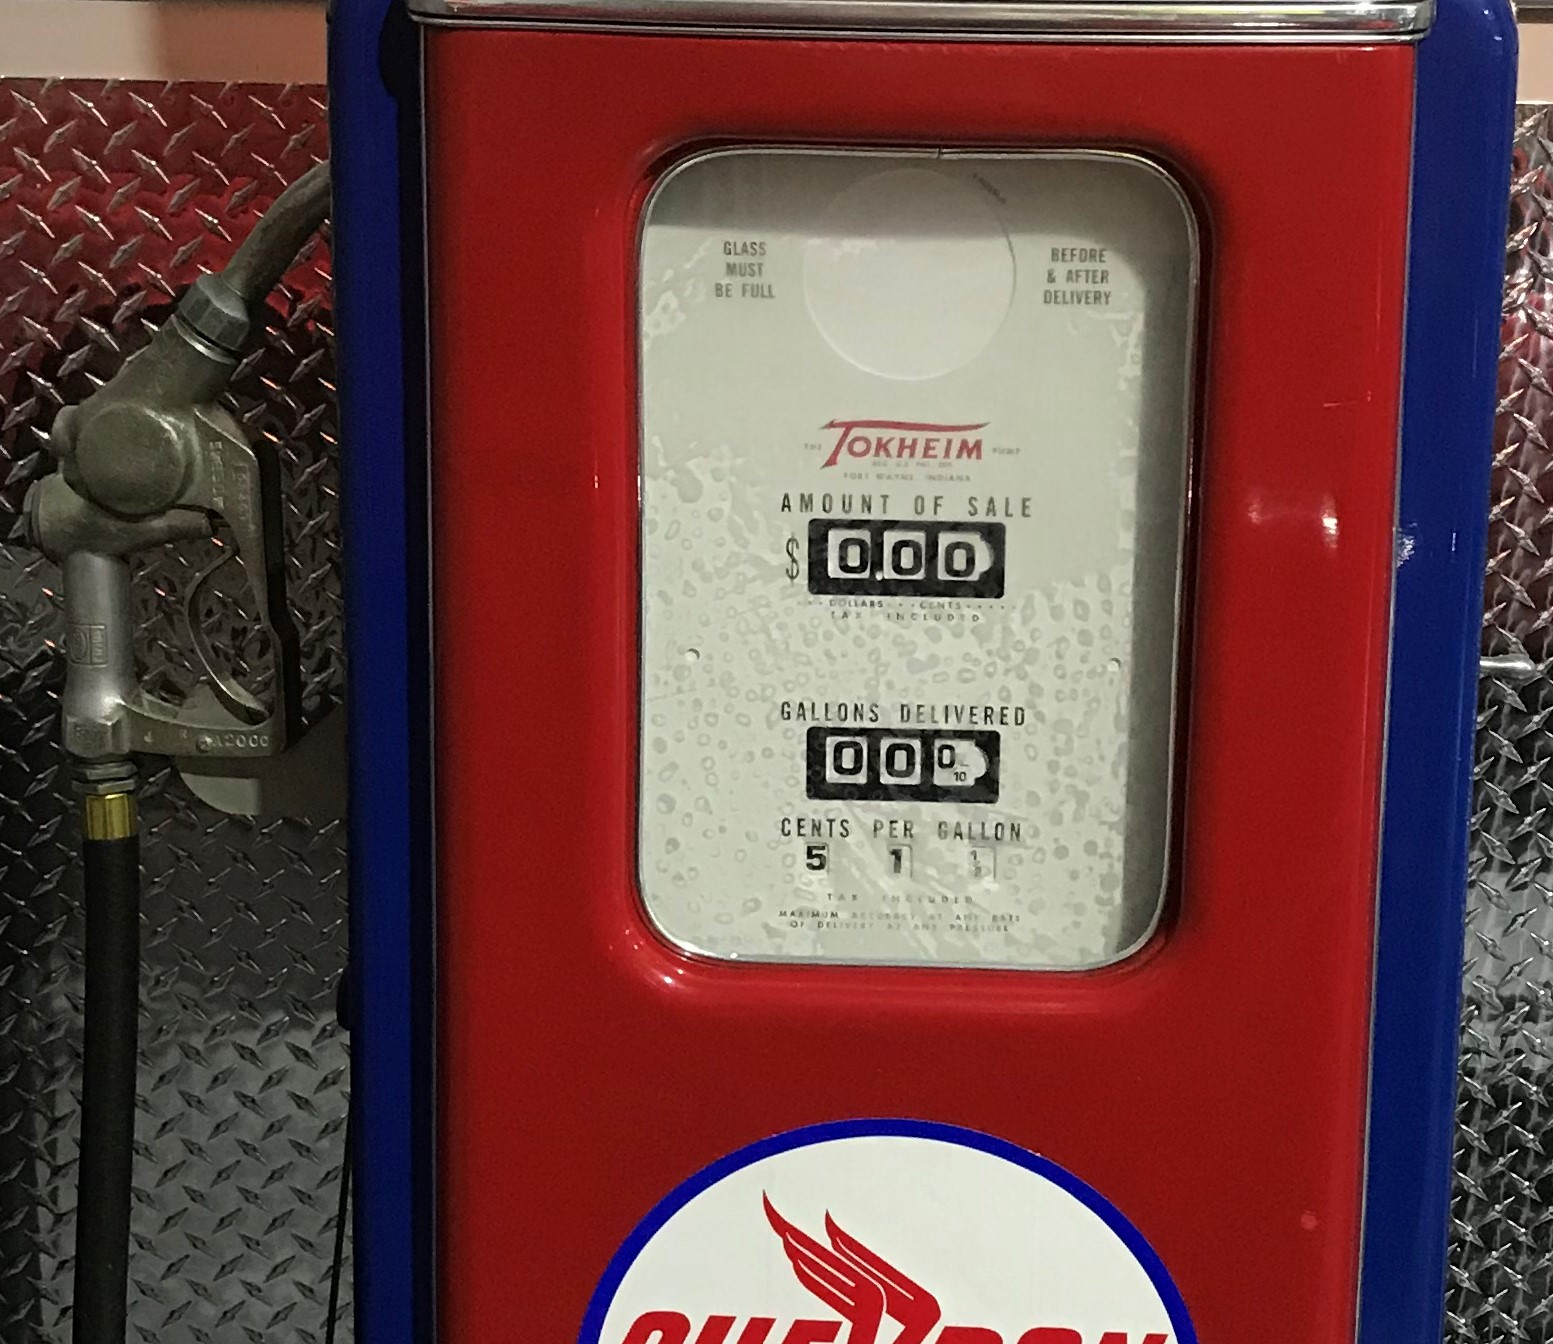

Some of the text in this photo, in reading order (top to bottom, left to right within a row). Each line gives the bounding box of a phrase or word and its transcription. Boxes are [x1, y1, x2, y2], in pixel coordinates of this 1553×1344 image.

[723, 241, 766, 256] GLASS
[1051, 247, 1107, 263] BEFORE
[726, 262, 764, 278] MUST
[1047, 269, 1109, 285] & AFTER
[715, 283, 775, 299] BE FULL
[1043, 290, 1111, 306] DELIVERY
[819, 419, 991, 470] TOKHEIM
[781, 492, 1032, 518] AMOUNT OF SALE
[785, 532, 800, 586] $
[780, 701, 1026, 726] GALLONS DELIVERED
[781, 817, 1021, 842] CENTS PER GALLON
[806, 845, 827, 871] 5
[890, 848, 903, 874] 1
